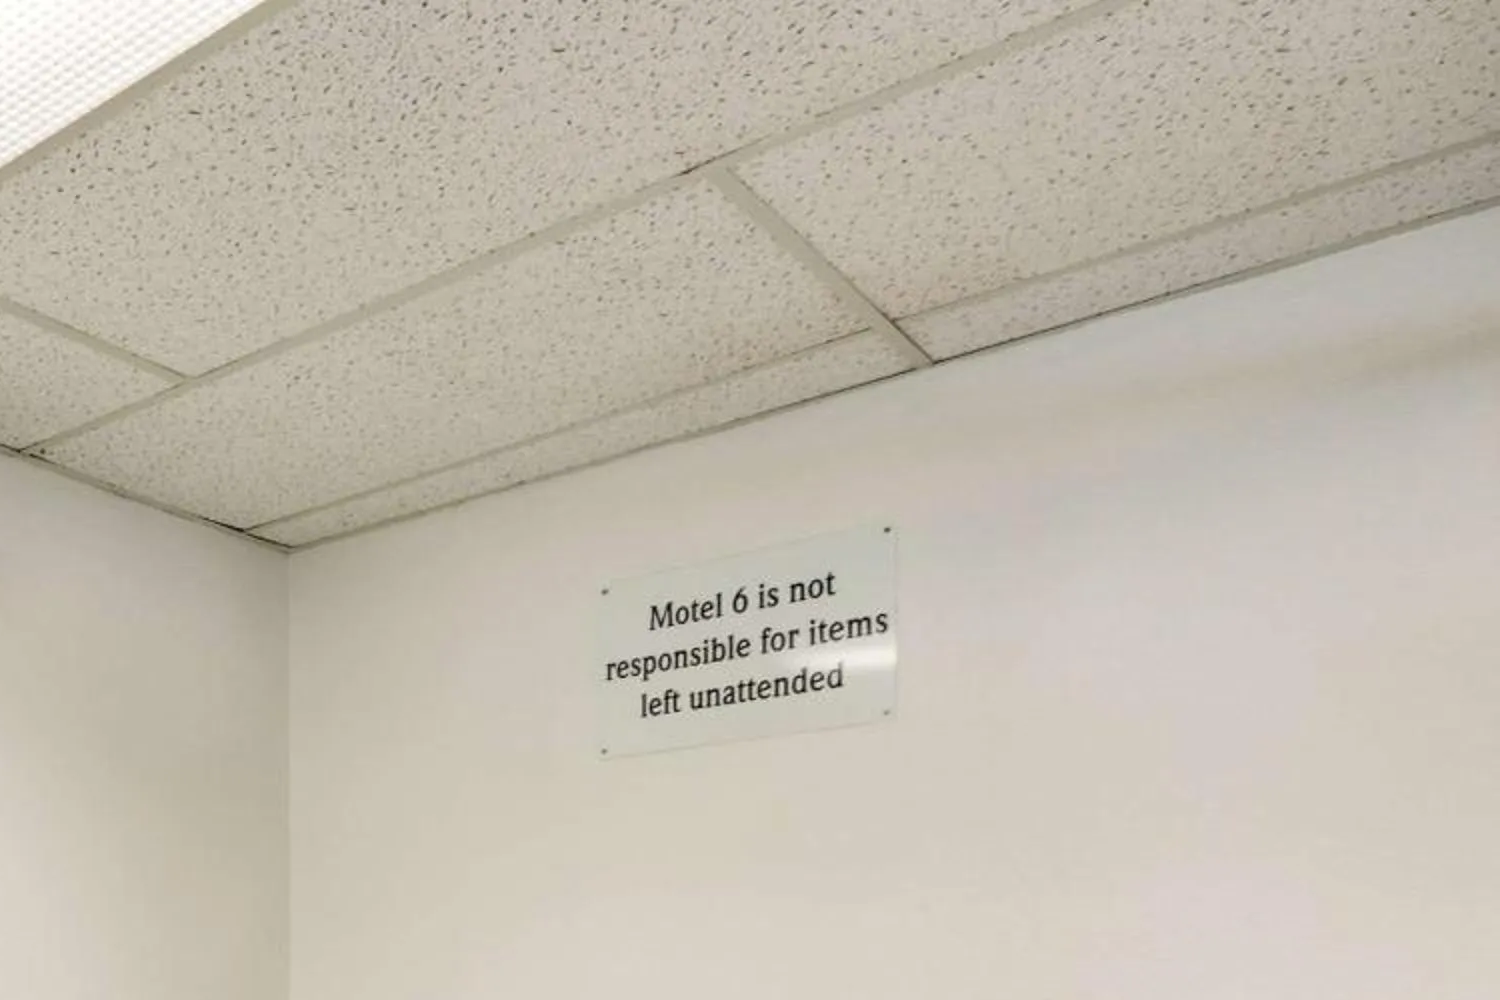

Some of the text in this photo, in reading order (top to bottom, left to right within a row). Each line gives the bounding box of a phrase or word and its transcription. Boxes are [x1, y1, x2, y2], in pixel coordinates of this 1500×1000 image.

[648, 571, 837, 631] Motel 6 is not
[605, 611, 890, 682] responsible for items
[640, 661, 846, 719] left unattended
